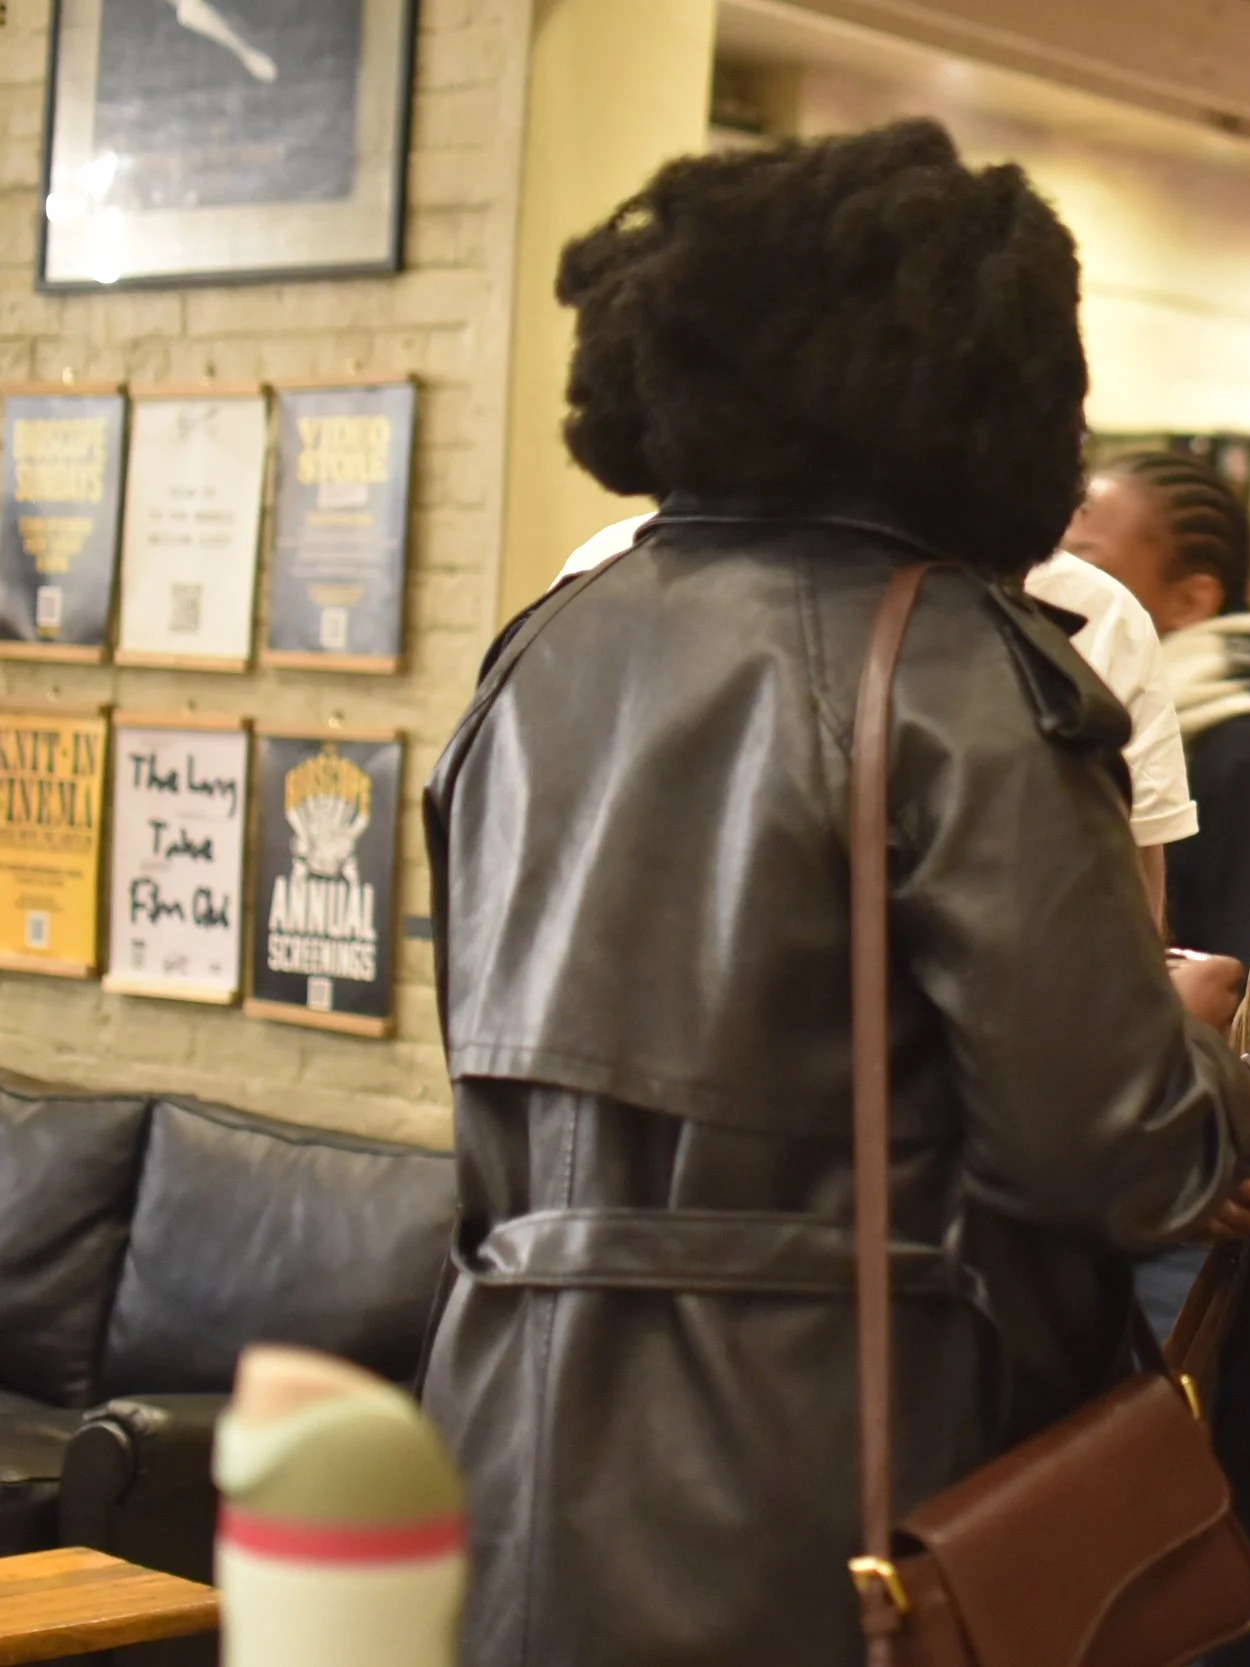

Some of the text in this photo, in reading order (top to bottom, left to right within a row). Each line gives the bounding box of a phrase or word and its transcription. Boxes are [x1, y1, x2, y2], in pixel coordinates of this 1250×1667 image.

[129, 750, 179, 793] The
[0, 776, 94, 828] INEMA
[268, 874, 376, 940] ANNUAL
[267, 935, 376, 982] SCREENINGS
